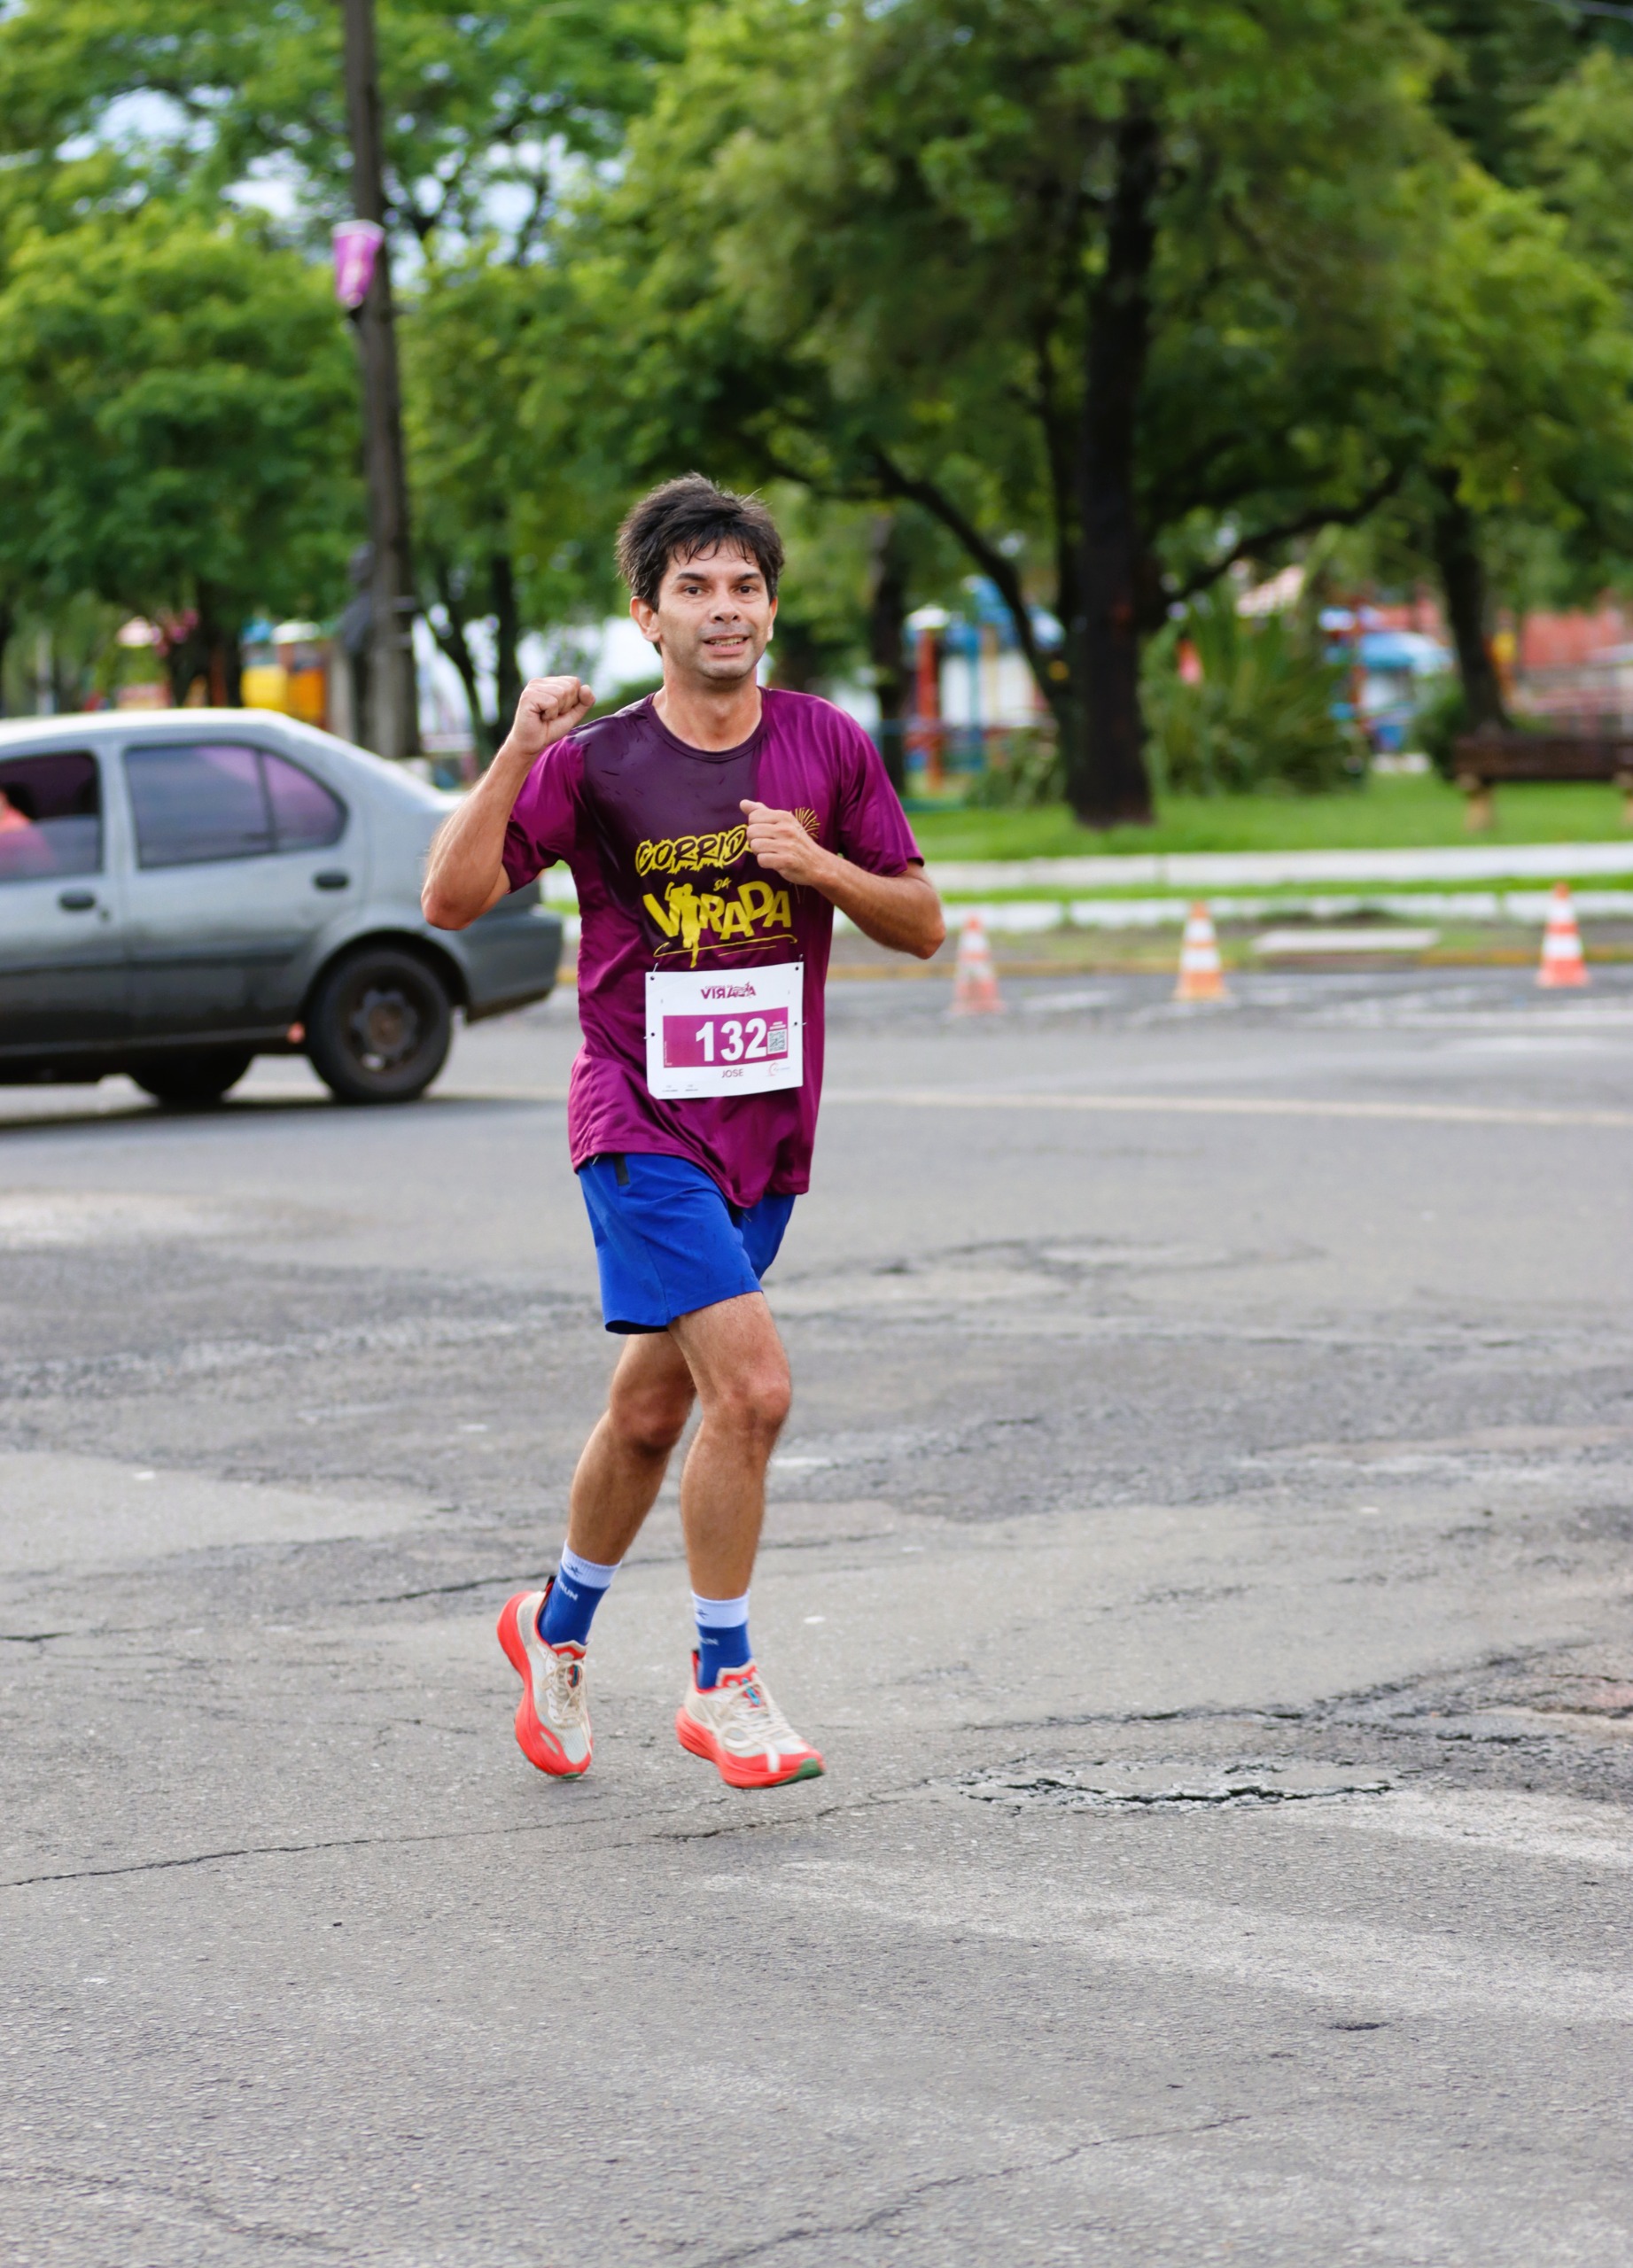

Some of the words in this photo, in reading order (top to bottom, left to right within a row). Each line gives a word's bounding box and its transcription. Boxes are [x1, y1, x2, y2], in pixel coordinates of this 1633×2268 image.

[635, 824, 753, 876] CORRID
[696, 1018, 767, 1062] 132
[721, 1068, 744, 1078] JOSE
